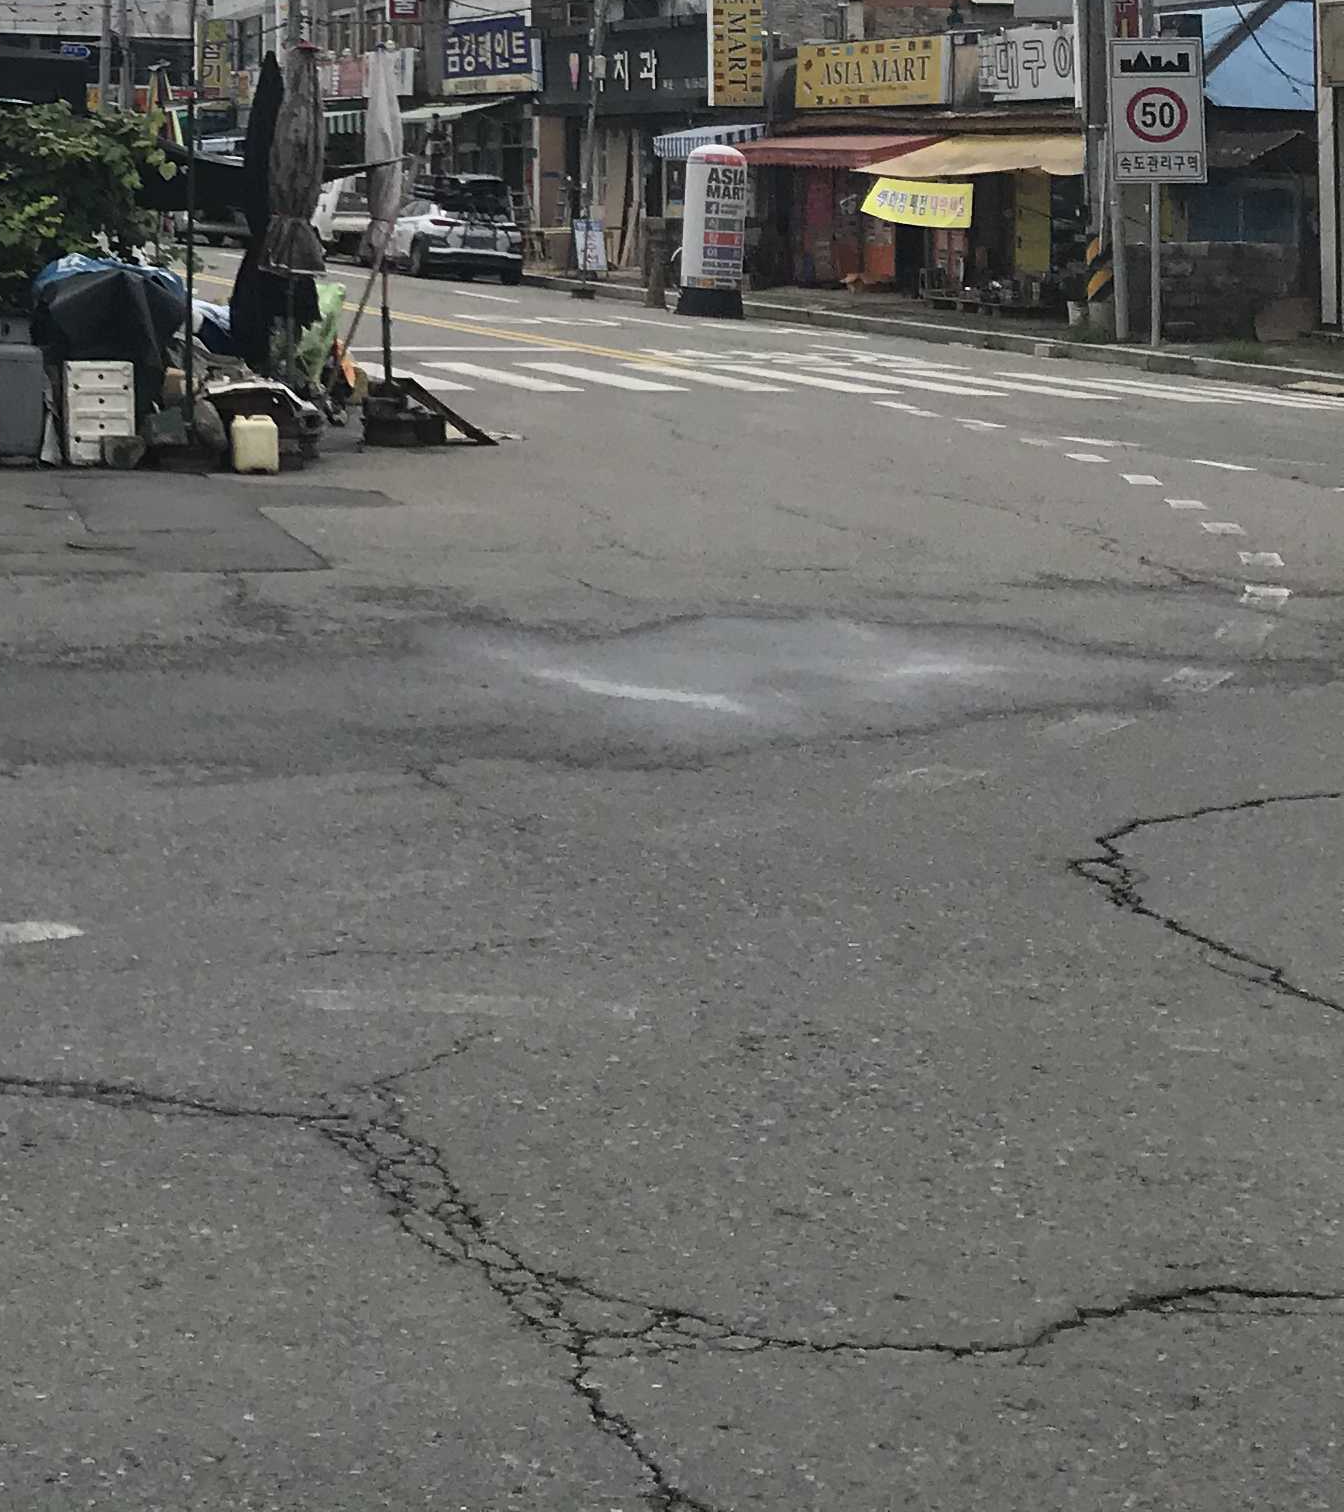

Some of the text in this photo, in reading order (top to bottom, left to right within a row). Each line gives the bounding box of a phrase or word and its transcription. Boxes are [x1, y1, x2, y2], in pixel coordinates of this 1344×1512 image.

[446, 29, 529, 73] 금강페인트
[728, 11, 749, 92] MART
[820, 56, 931, 85] ASIA MART
[1140, 101, 1175, 129] 50
[707, 167, 745, 185] ASIA
[1120, 154, 1198, 173] 속도관리구역
[706, 185, 745, 200] MART
